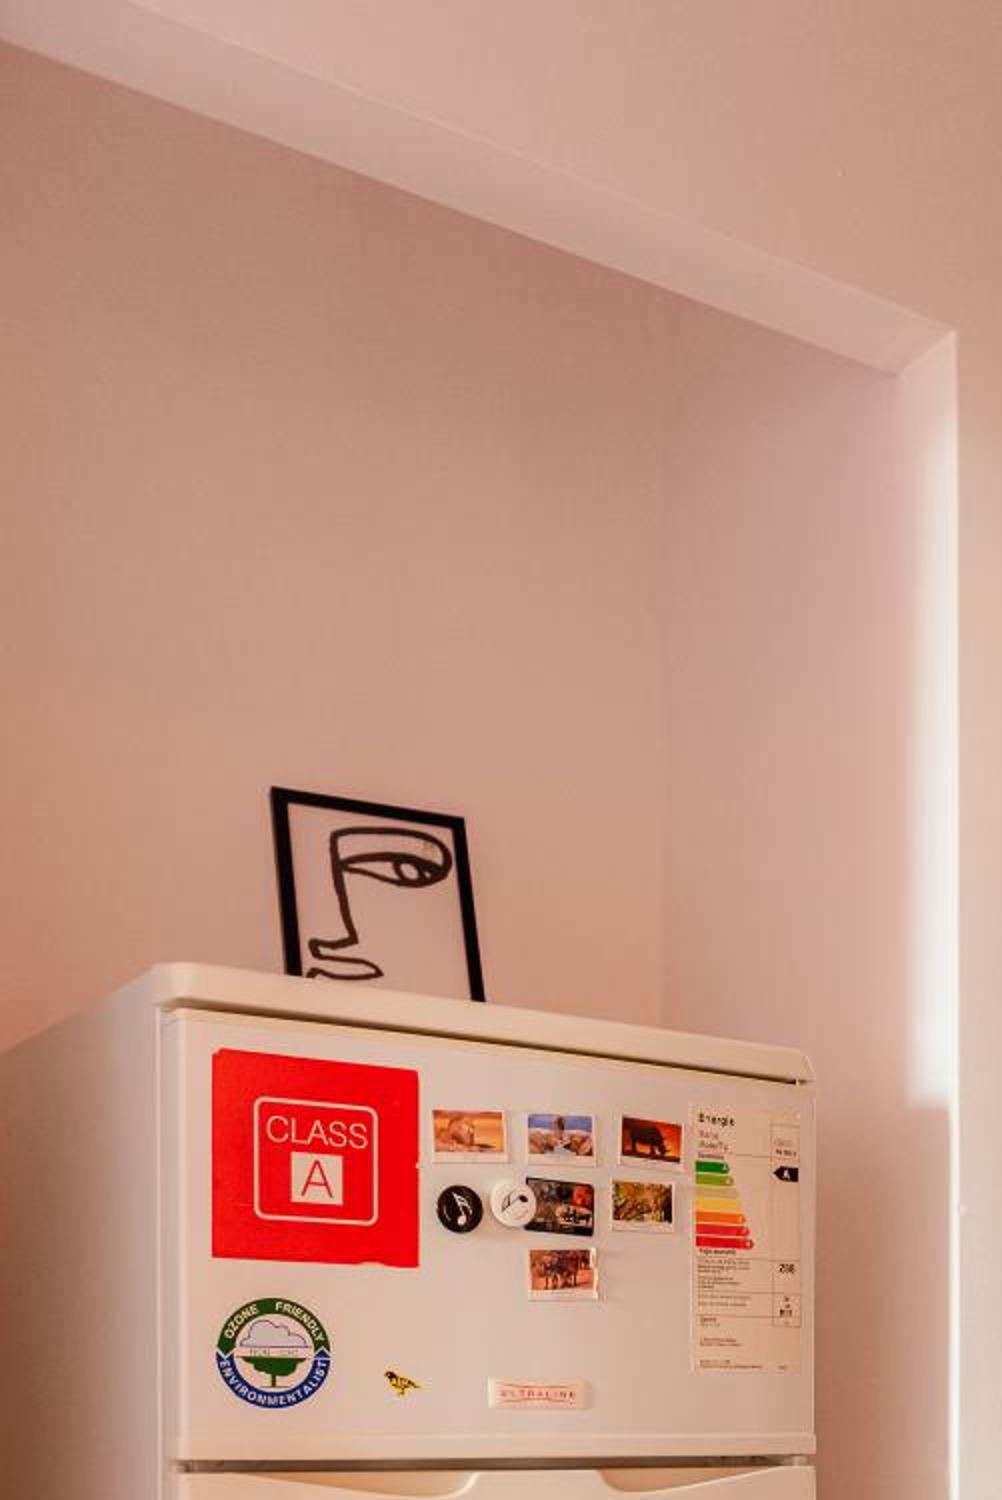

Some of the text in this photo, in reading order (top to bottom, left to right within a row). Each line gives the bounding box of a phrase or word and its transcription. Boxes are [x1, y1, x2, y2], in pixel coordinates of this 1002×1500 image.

[266, 1114, 369, 1149] CLASS
[301, 1159, 334, 1199] A
[782, 1169, 791, 1180] A
[224, 1301, 326, 1342] OZONE FRIENDLY
[219, 1358, 328, 1406] ENVIRONMENTALIST
